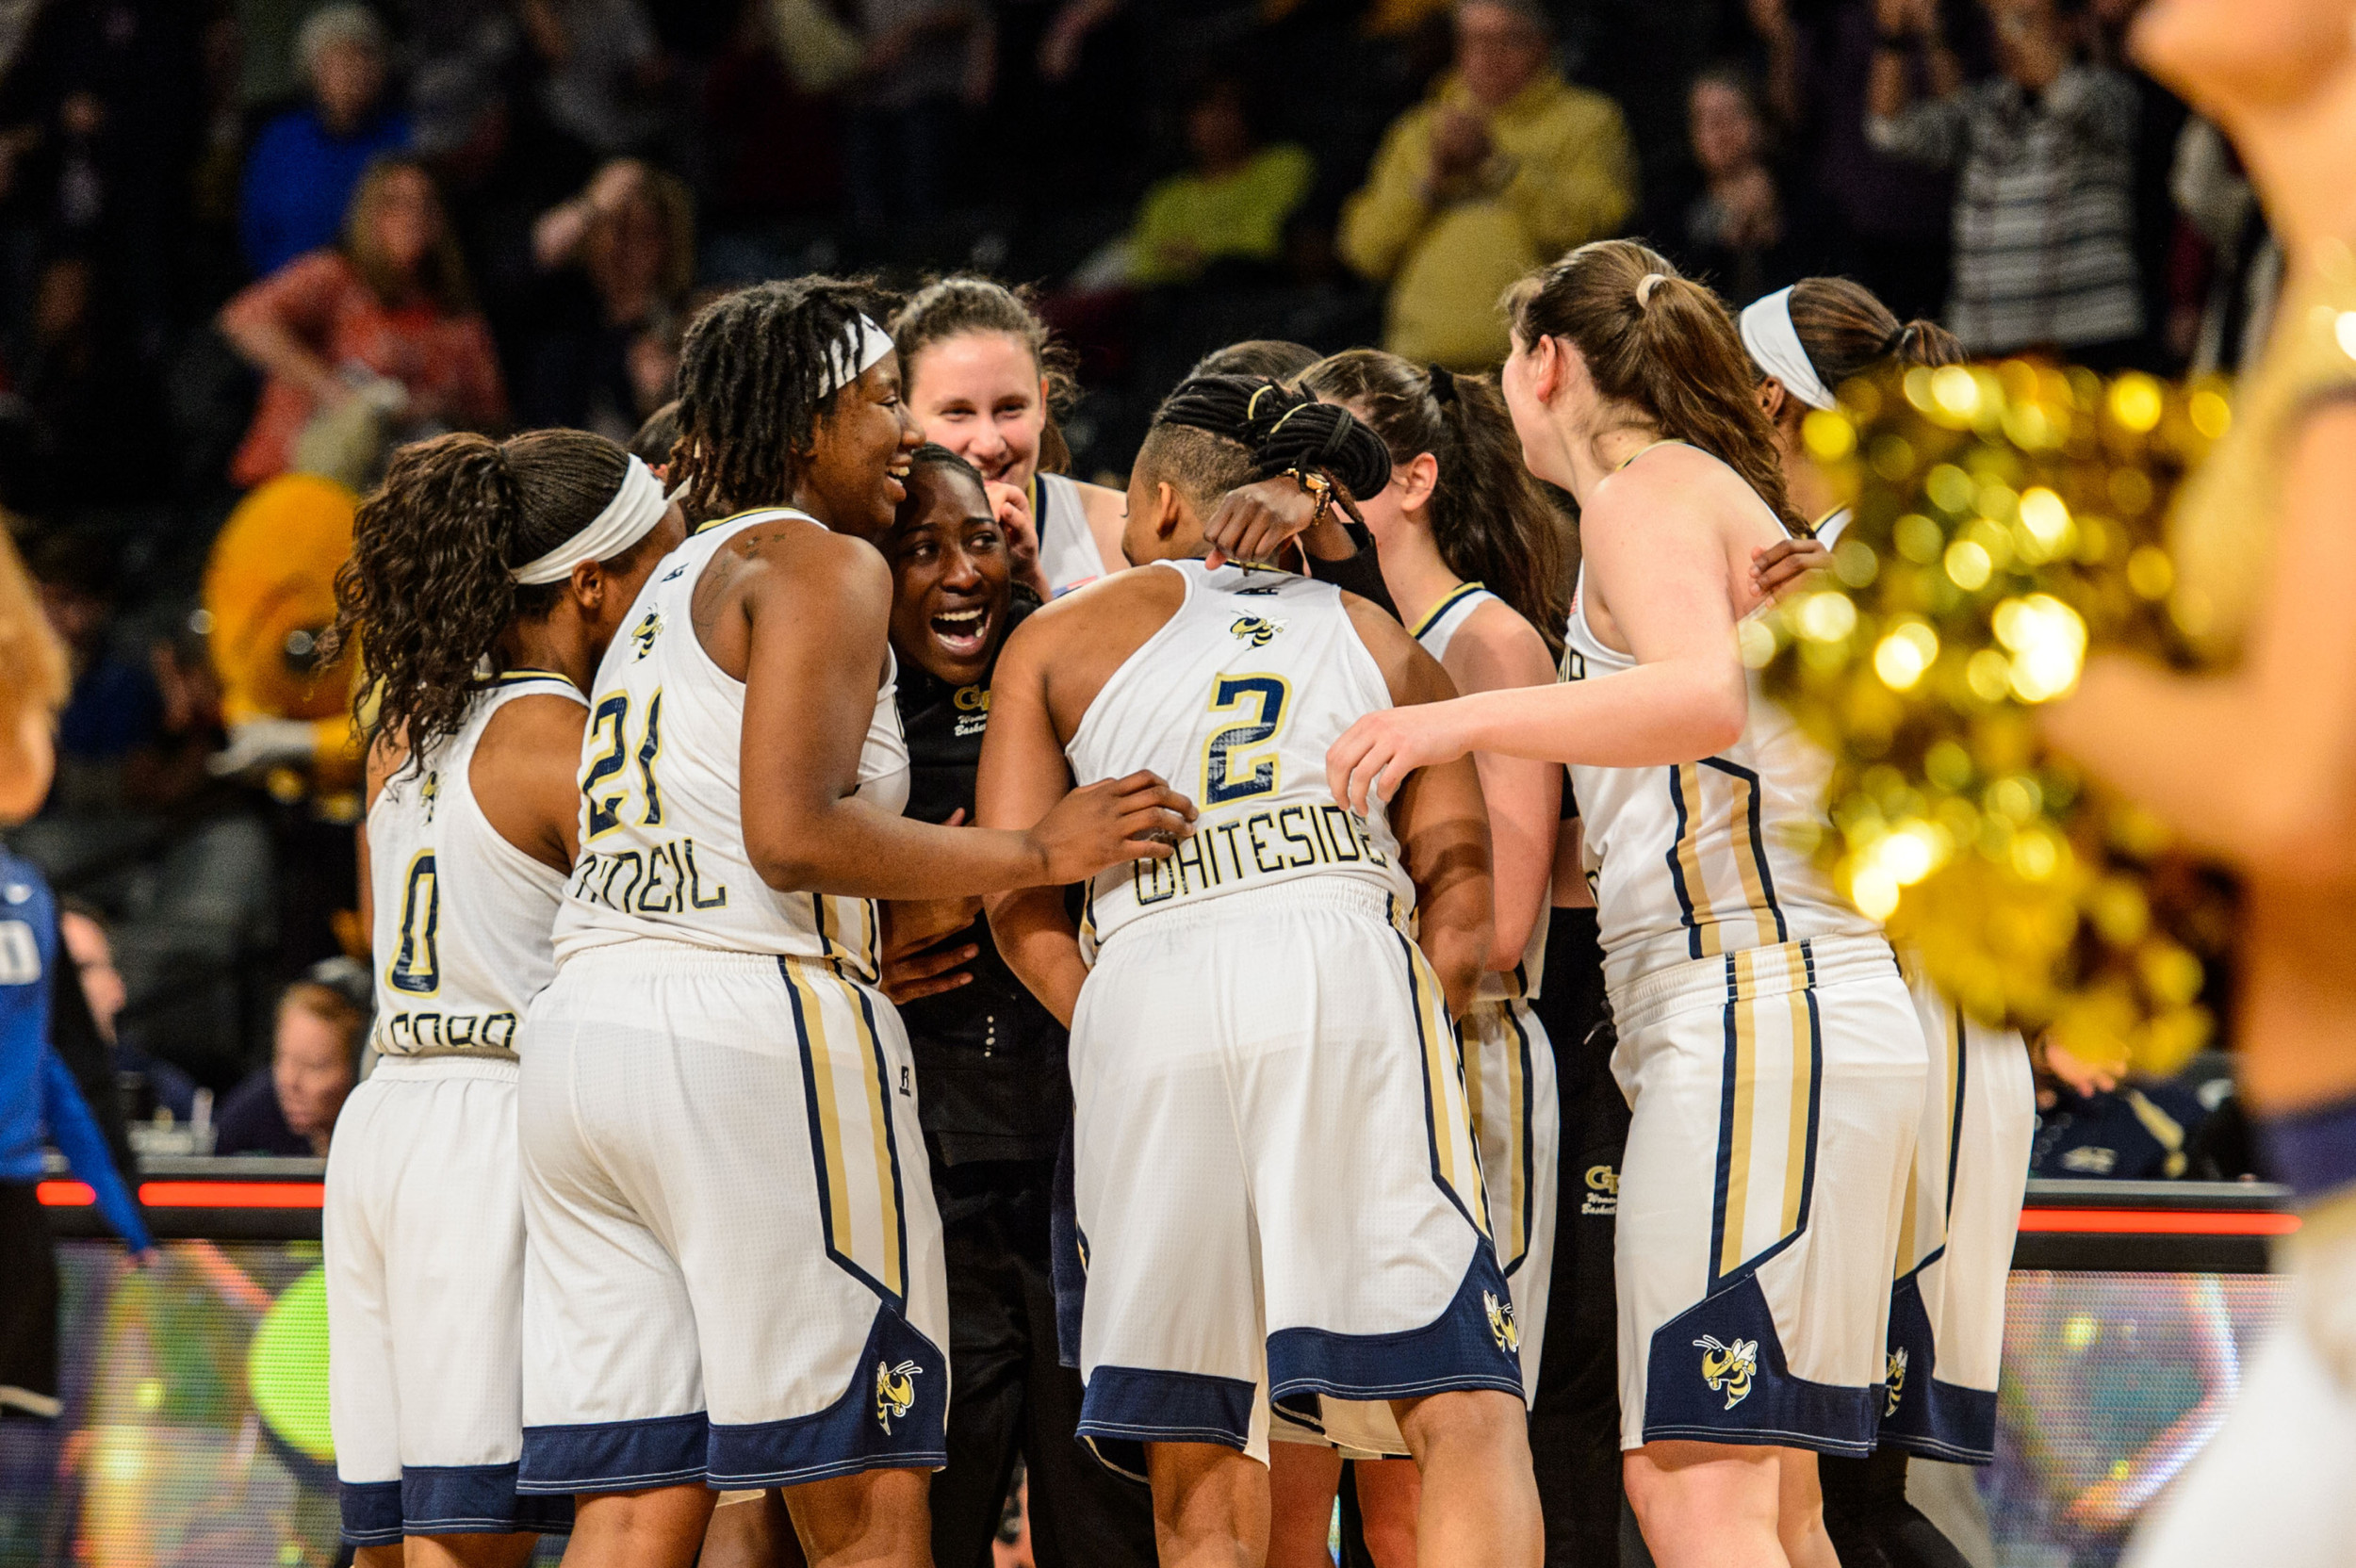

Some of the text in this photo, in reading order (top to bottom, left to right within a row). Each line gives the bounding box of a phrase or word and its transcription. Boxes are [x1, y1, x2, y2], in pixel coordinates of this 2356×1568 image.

[581, 687, 665, 844] 21
[1200, 672, 1292, 813] 2
[385, 848, 440, 999] 0
[1133, 805, 1390, 906] WHITESIDE
